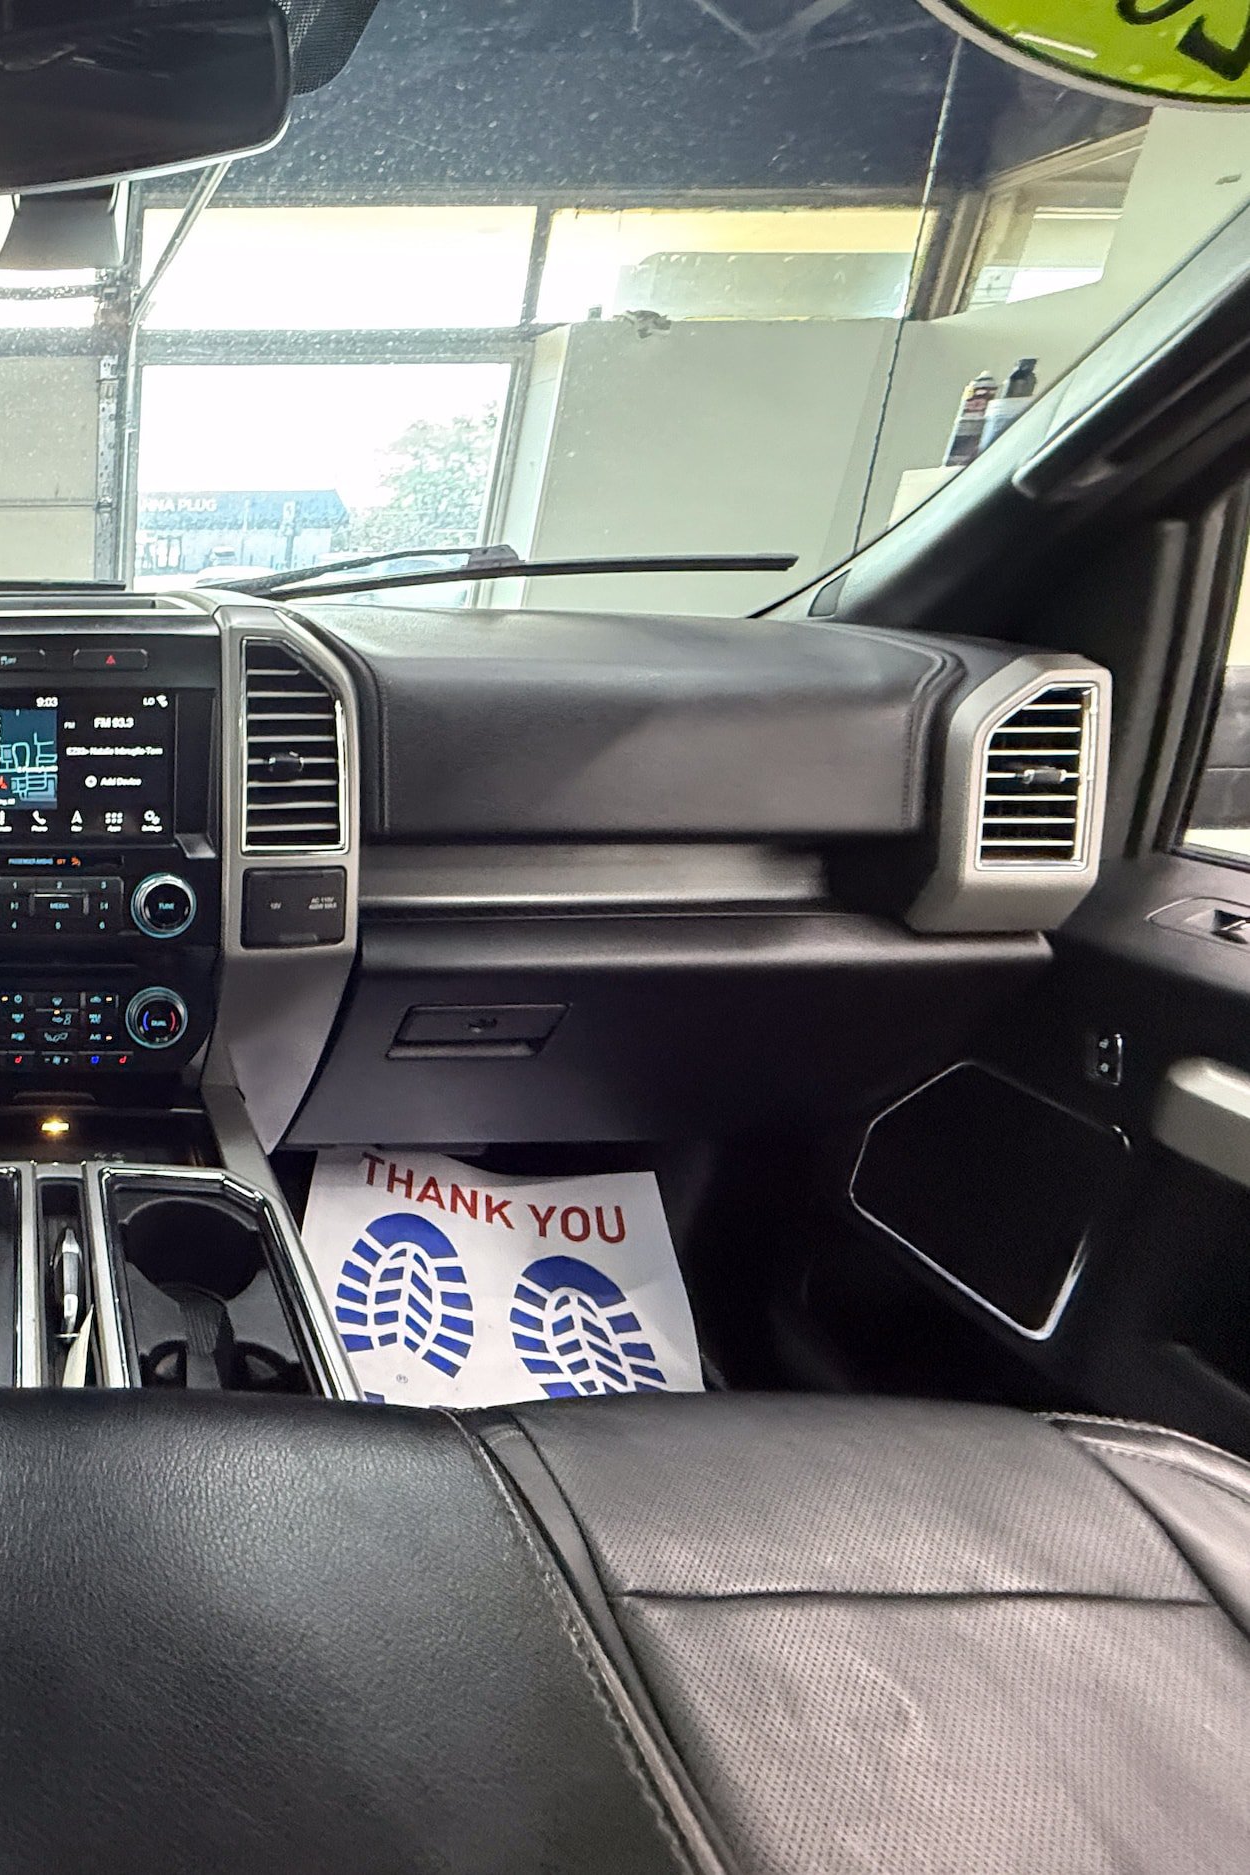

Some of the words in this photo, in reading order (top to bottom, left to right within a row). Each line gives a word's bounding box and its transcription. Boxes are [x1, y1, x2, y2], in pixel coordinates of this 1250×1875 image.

[177, 498, 218, 512] PLUG
[94, 717, 111, 728] FM
[362, 1152, 515, 1231] THANK
[528, 1204, 626, 1244] YOU
